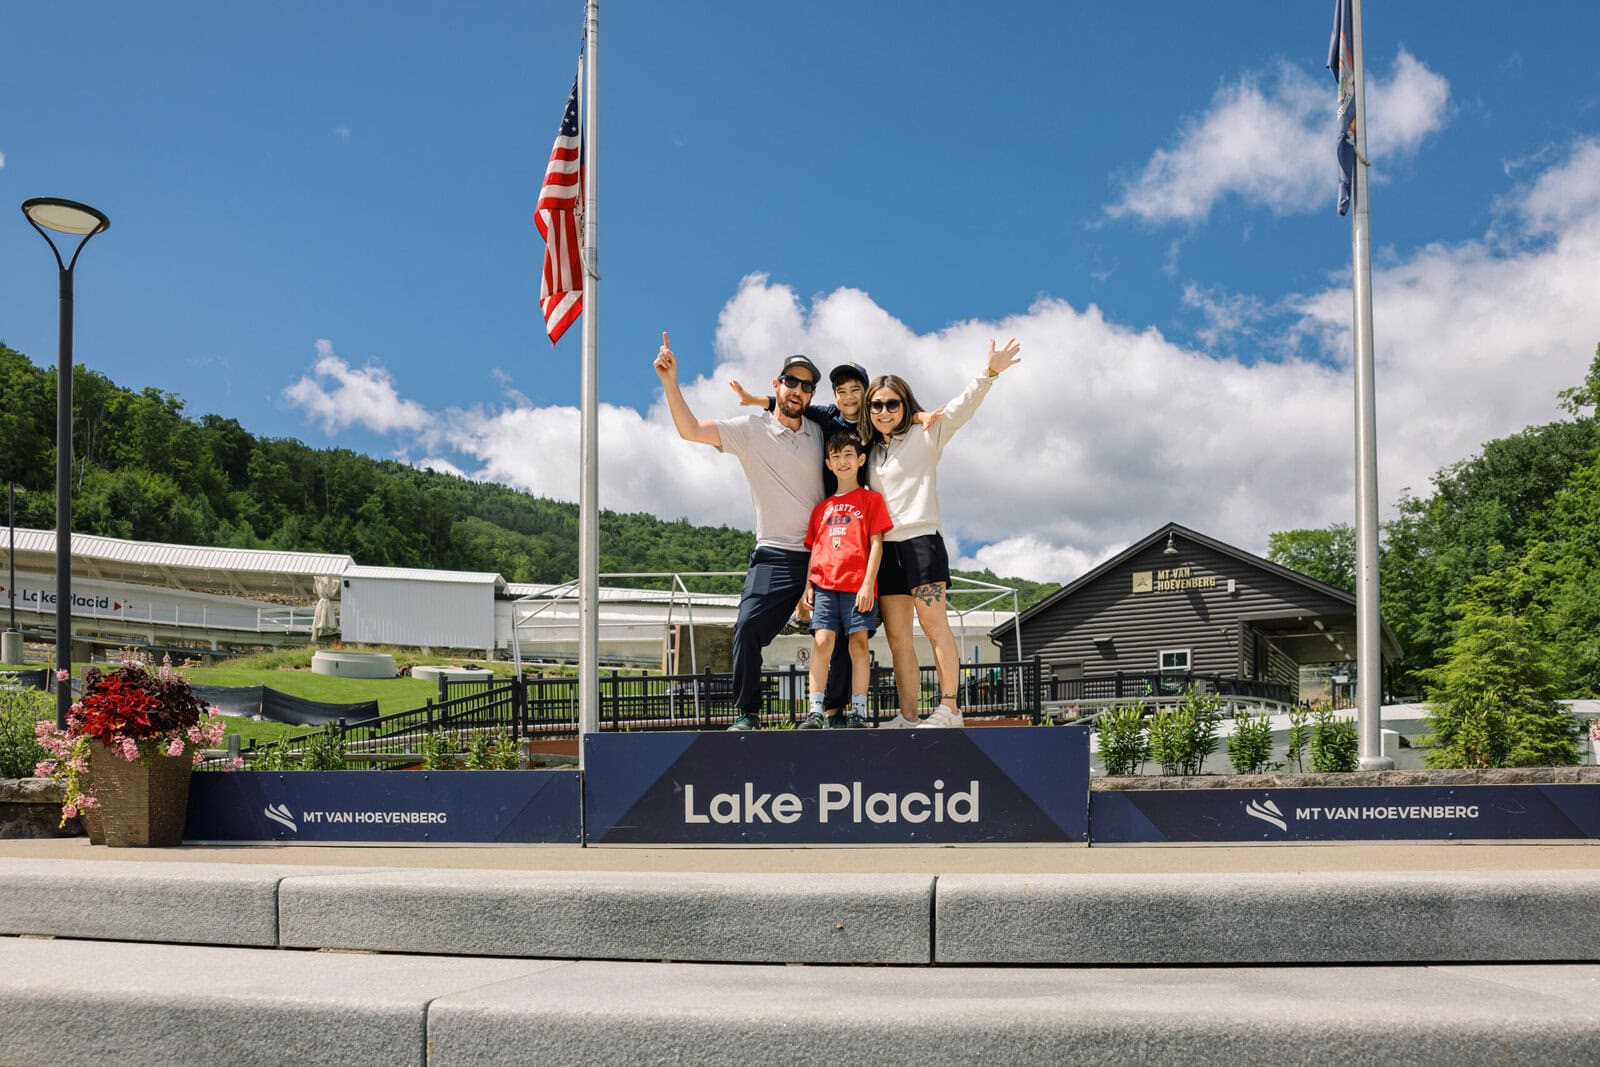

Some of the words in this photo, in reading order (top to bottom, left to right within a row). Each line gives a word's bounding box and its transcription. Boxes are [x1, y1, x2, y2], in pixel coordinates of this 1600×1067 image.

[1157, 570, 1170, 580] MT
[1173, 567, 1191, 578] VAN
[1157, 576, 1216, 591] HOEVENBERG
[70, 593, 109, 608] lacid
[684, 782, 803, 824] Lake
[819, 779, 979, 823] Placid
[303, 811, 323, 823] MT
[325, 811, 353, 823] VAN
[355, 811, 447, 824] HOEVENBERG
[1295, 807, 1321, 820] MT
[1324, 807, 1359, 820] VAN
[1362, 806, 1479, 819] HOEVENBERG
